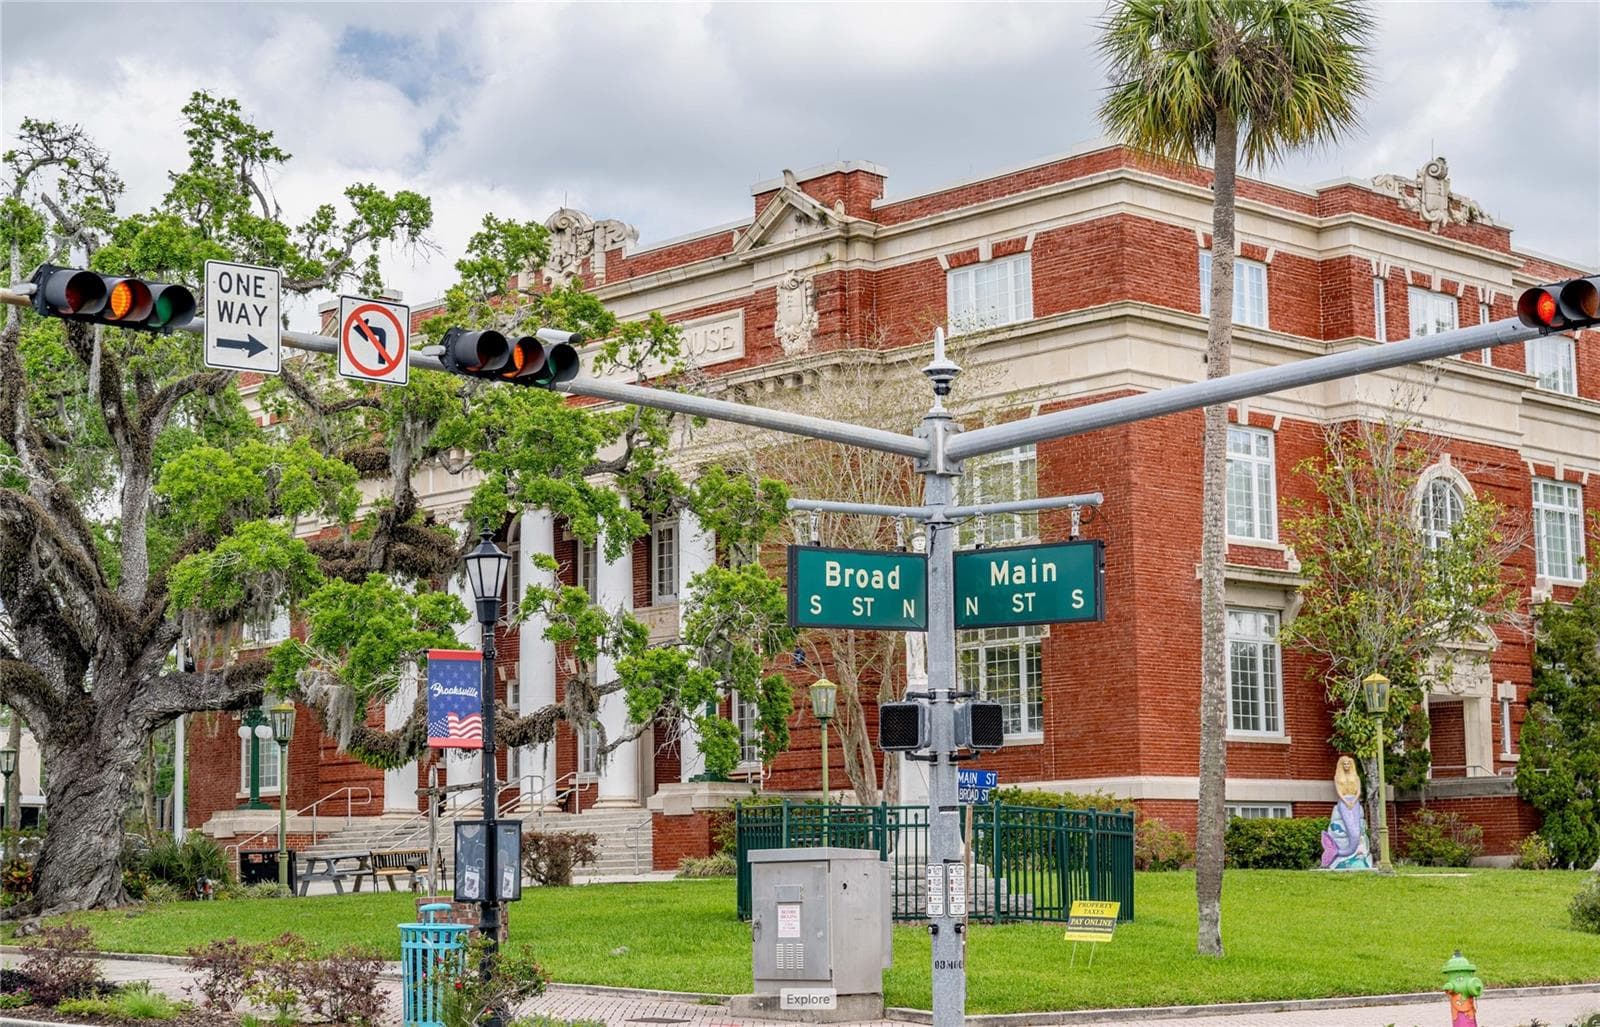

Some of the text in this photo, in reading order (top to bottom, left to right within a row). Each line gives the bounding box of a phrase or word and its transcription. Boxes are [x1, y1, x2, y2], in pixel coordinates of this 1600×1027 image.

[219, 271, 266, 299] ONE
[217, 300, 268, 327] WAY
[665, 326, 735, 360] OUSE
[825, 560, 901, 590] Broad
[990, 557, 1057, 586] Main
[809, 594, 915, 618] S ST N
[965, 588, 1085, 616] N ST S
[430, 682, 479, 698] Brooksville
[958, 771, 996, 786] MAIN ST
[960, 788, 989, 801] BROAD ST
